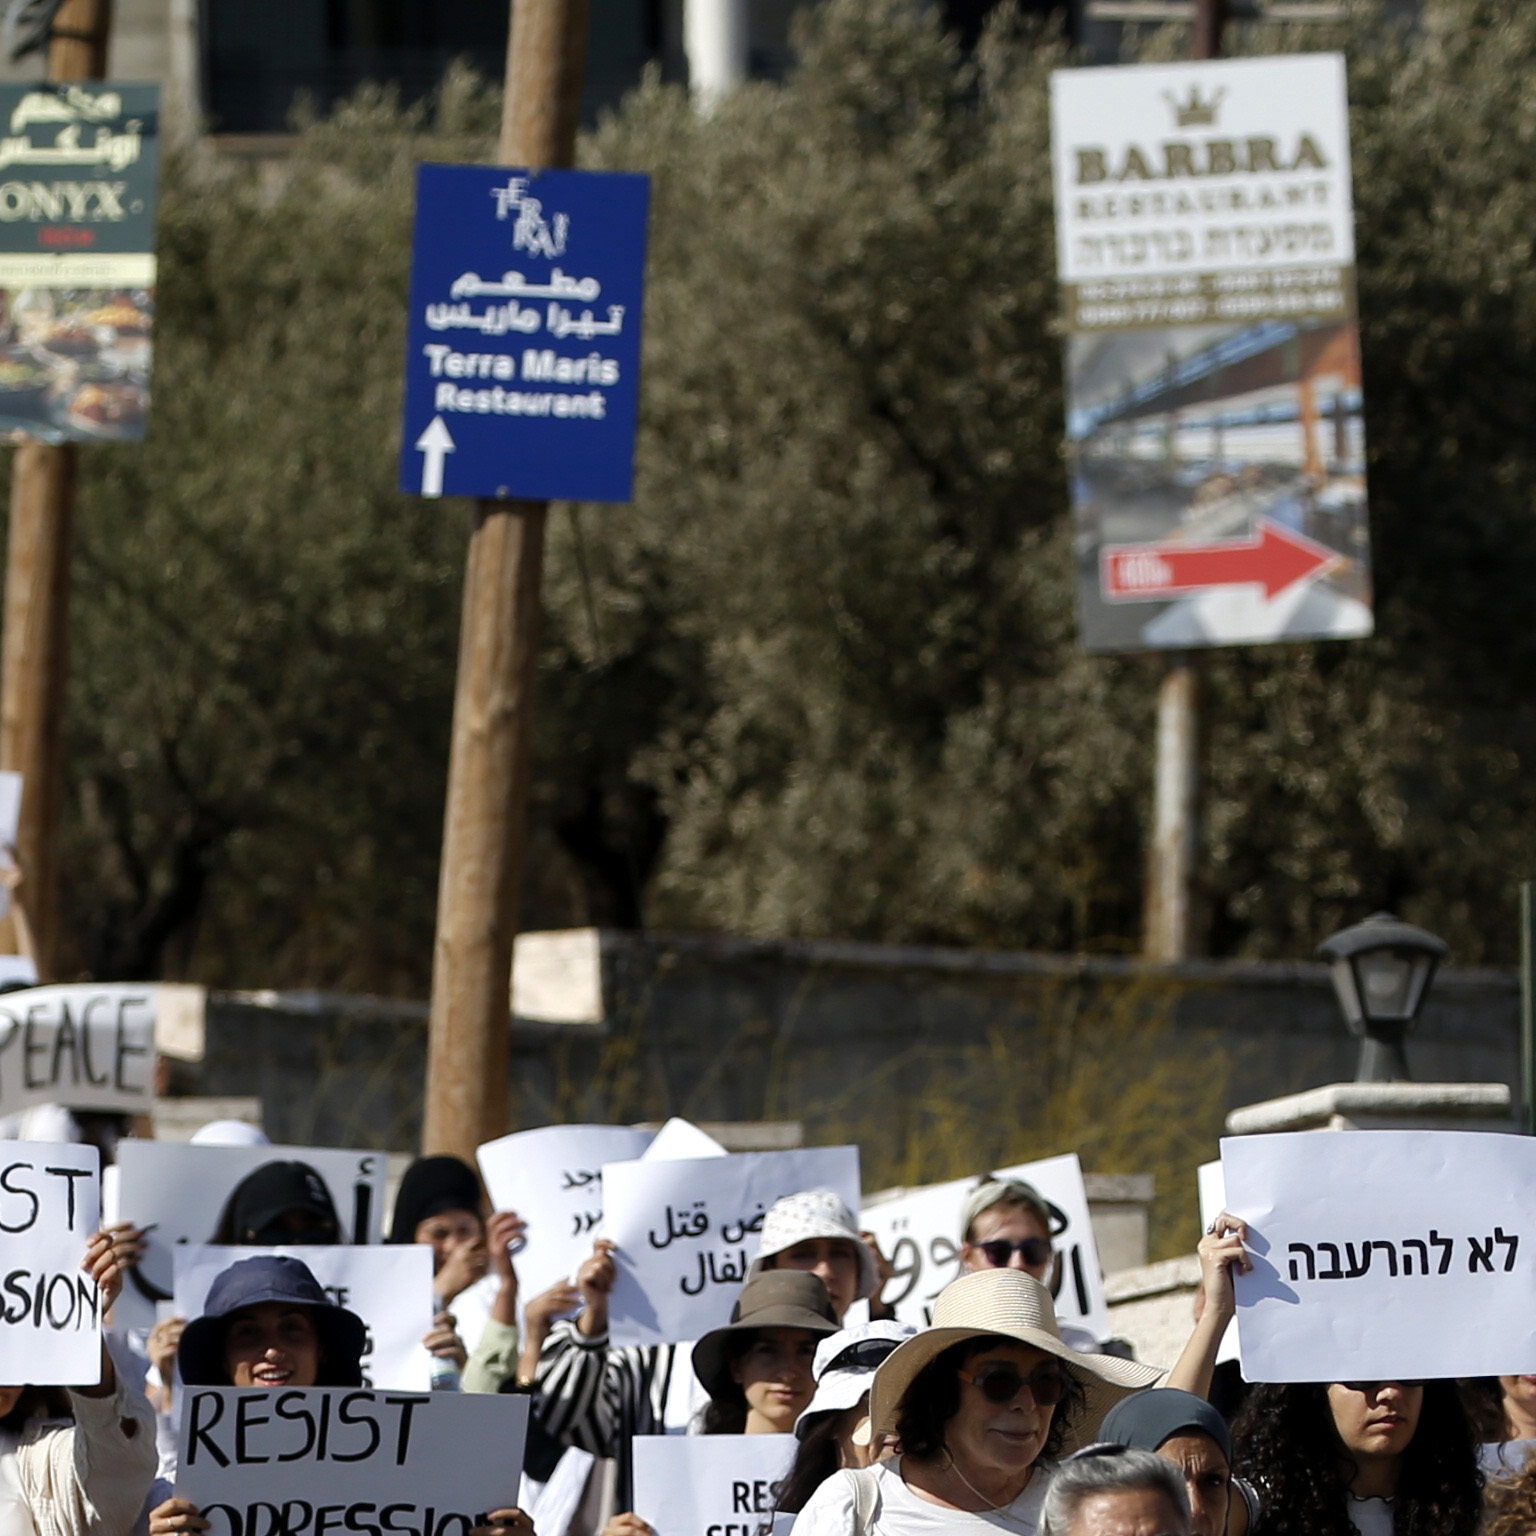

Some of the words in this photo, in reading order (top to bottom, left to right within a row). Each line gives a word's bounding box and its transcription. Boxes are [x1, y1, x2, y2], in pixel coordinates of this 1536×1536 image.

[1076, 134, 1327, 186] BARBRA
[1077, 181, 1330, 220] RESTAURANT
[449, 267, 602, 302] مطعم
[425, 299, 542, 336] ماريس
[547, 301, 626, 339] تيرا
[423, 343, 515, 379] Terra
[521, 348, 621, 387] Maris
[434, 382, 607, 421] Restaurant
[648, 1201, 710, 1250] قتل
[1287, 1229, 1454, 1282] להרעבה
[1466, 1227, 1519, 1274] לא
[185, 1389, 431, 1468] RESIST
